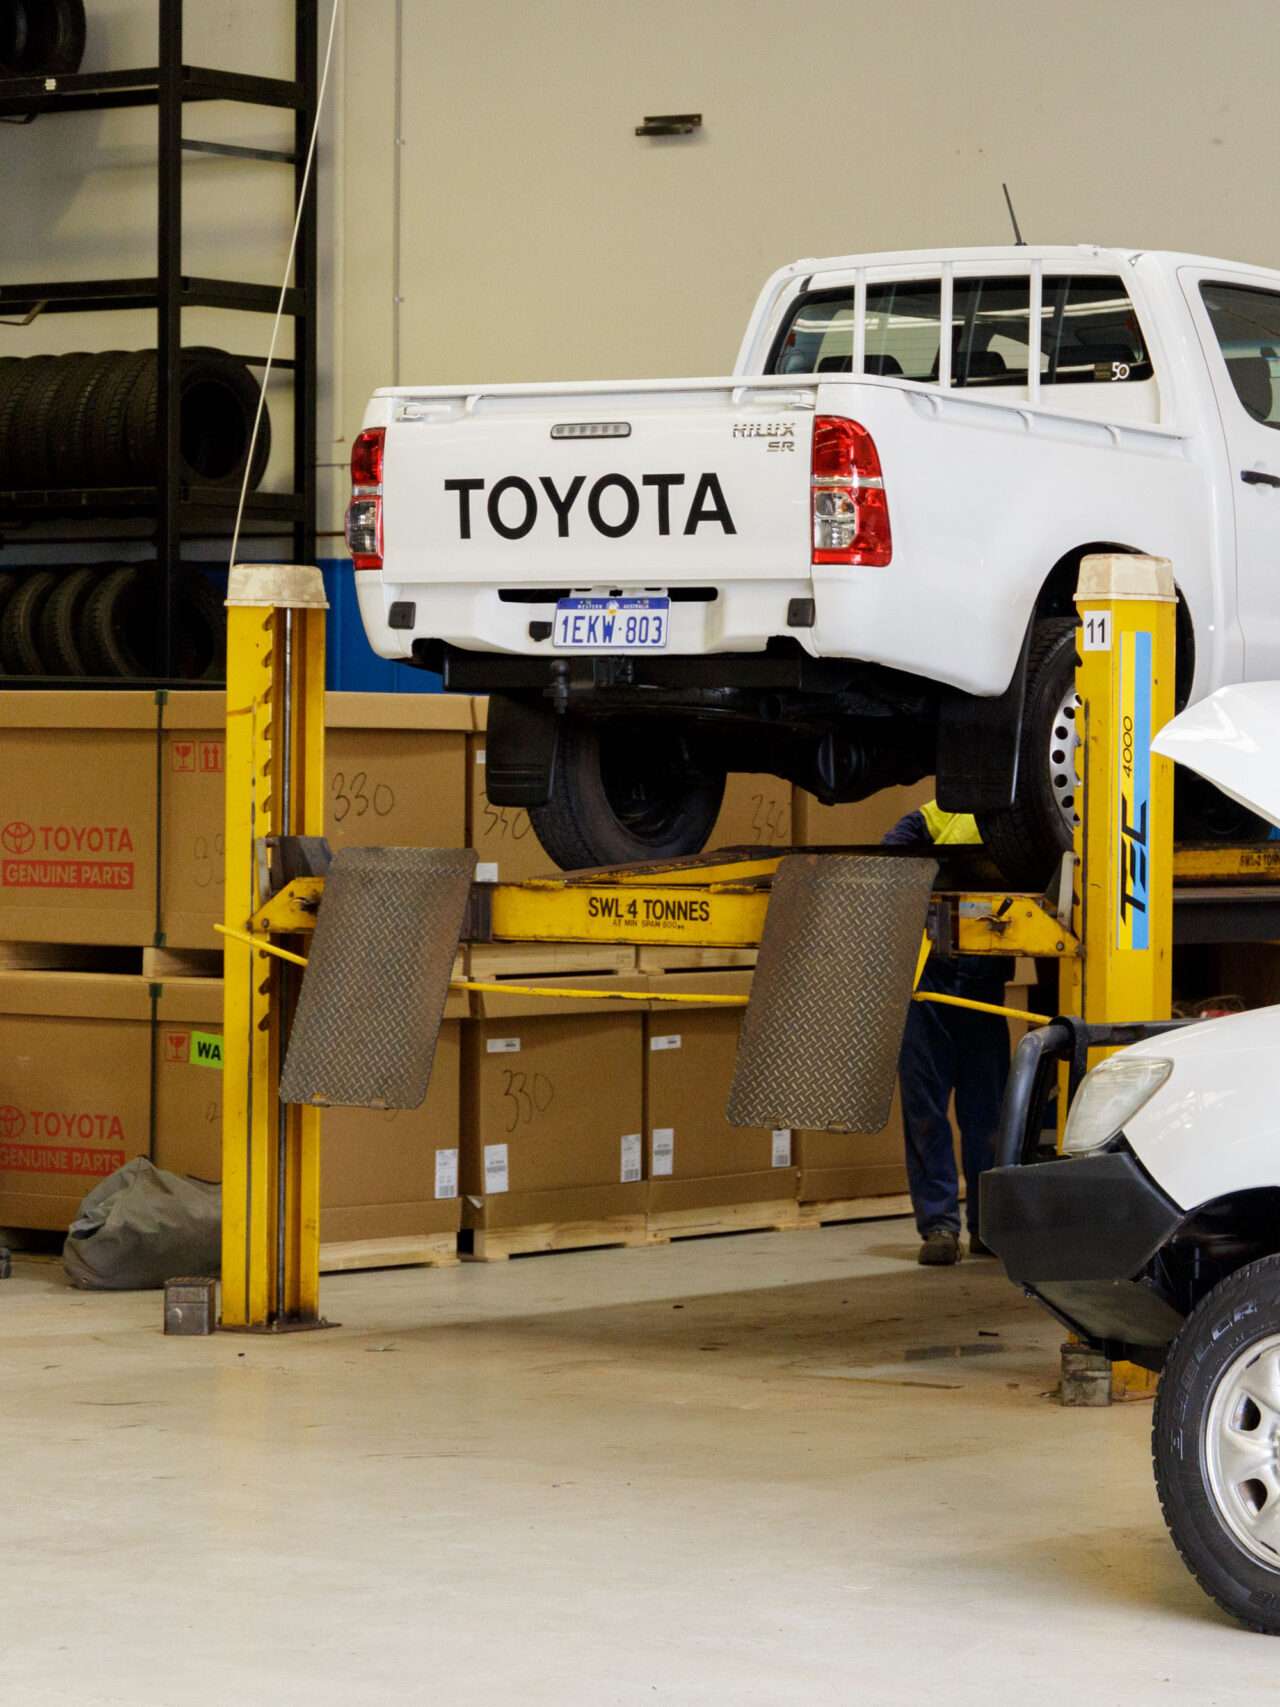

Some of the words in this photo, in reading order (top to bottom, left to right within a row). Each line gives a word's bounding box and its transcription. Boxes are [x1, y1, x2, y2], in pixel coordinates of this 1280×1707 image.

[1111, 362, 1130, 381] 50
[732, 422, 796, 438] HILUX
[766, 440, 795, 452] SR
[444, 472, 738, 540] TOYOTA
[1086, 617, 1106, 644] 11
[1121, 714, 1133, 779] 4000
[331, 771, 395, 823] 330
[39, 826, 135, 853] TOYOTA
[6, 863, 78, 883] GENUINE
[80, 865, 131, 885] PARTS
[588, 896, 624, 919] SWL
[627, 899, 638, 919] 4
[642, 899, 710, 922] TONNES
[503, 1068, 554, 1133] 330
[30, 1111, 125, 1140] TOYOTA
[0, 1147, 70, 1169] GENUINE
[72, 1150, 122, 1173] PARTS
